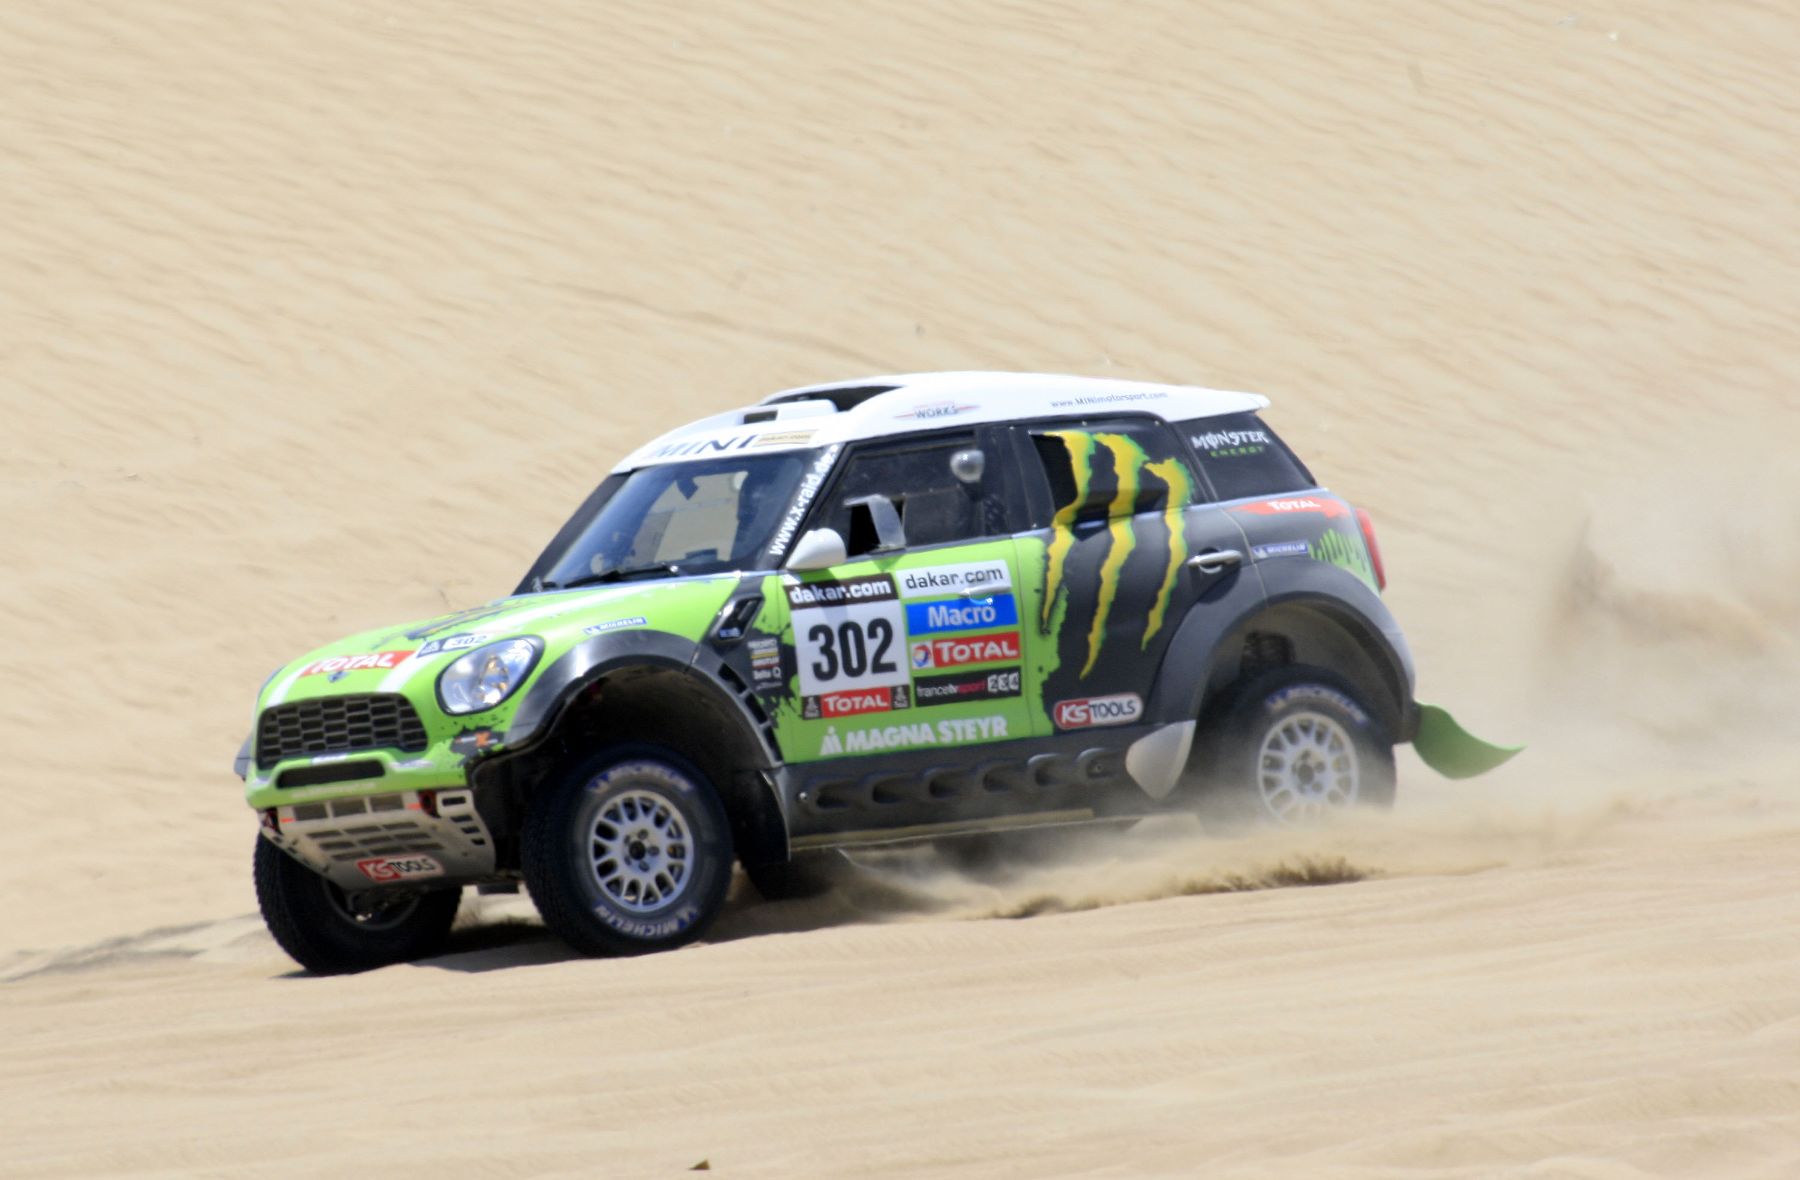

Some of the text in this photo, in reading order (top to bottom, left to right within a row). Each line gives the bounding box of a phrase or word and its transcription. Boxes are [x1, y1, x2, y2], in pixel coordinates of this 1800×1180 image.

[1266, 500, 1321, 511] TOTAL
[906, 567, 1004, 589] dakar.com
[789, 579, 892, 604] dakar.com
[928, 605, 996, 627] Macro
[808, 617, 897, 682] 302
[934, 641, 1018, 662] TOTAL
[312, 653, 394, 673] TOTAL
[823, 694, 889, 712] TOTAL
[846, 715, 1008, 752] MAGNA STEYR
